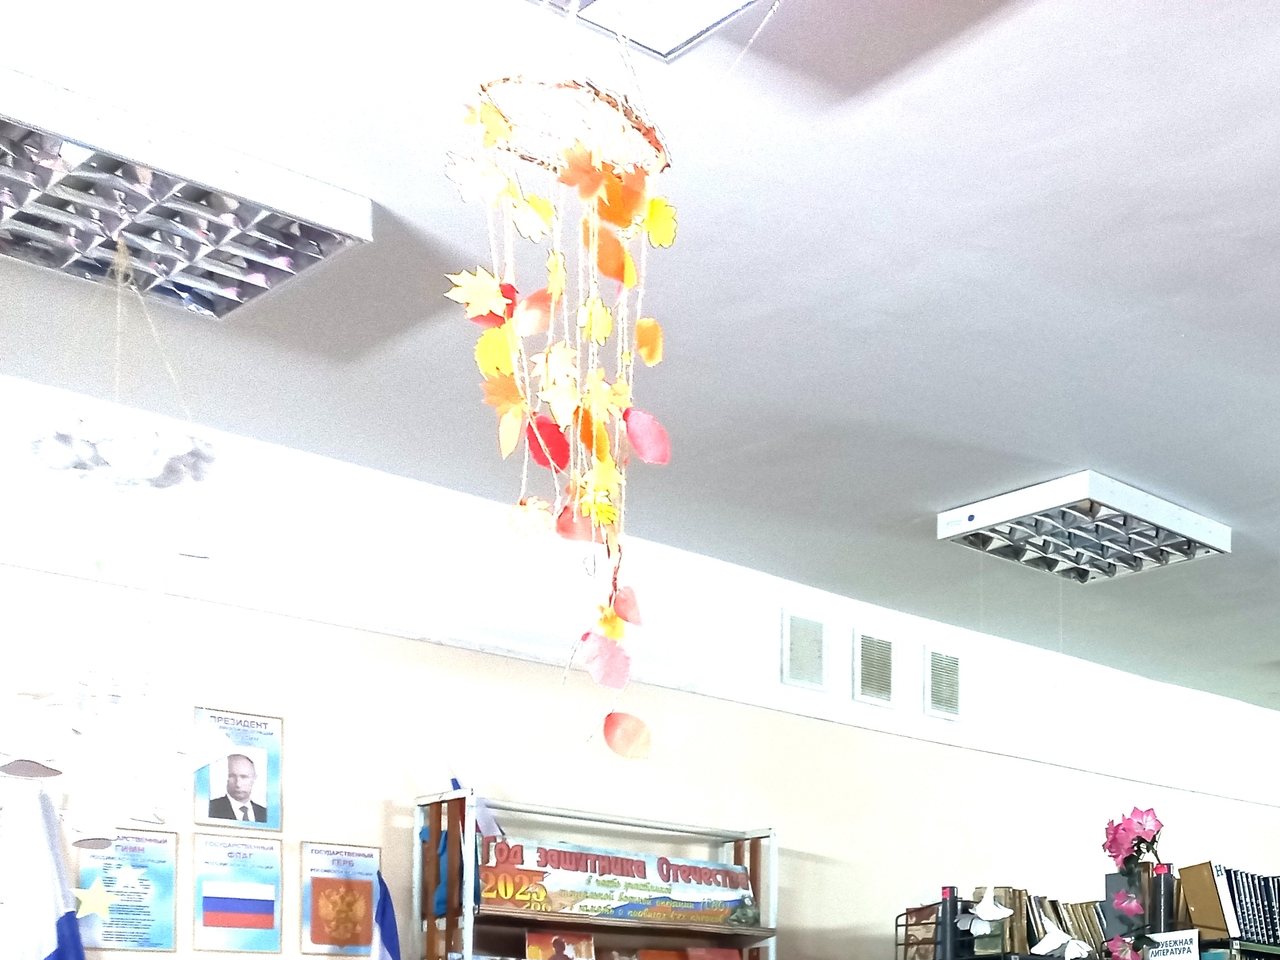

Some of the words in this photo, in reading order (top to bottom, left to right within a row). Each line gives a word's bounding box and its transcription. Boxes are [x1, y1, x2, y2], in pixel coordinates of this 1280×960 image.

[210, 716, 268, 730] ПРЕЗИДЕНТ
[310, 848, 374, 858] ГОСУДАРСТВЕННЫЙ
[332, 858, 354, 868] ГЕРБ
[482, 871, 548, 902] 2025
[1158, 938, 1194, 949] УБЕЖНАЯ
[1150, 946, 1192, 958] ЛИТЕРАТУРА
